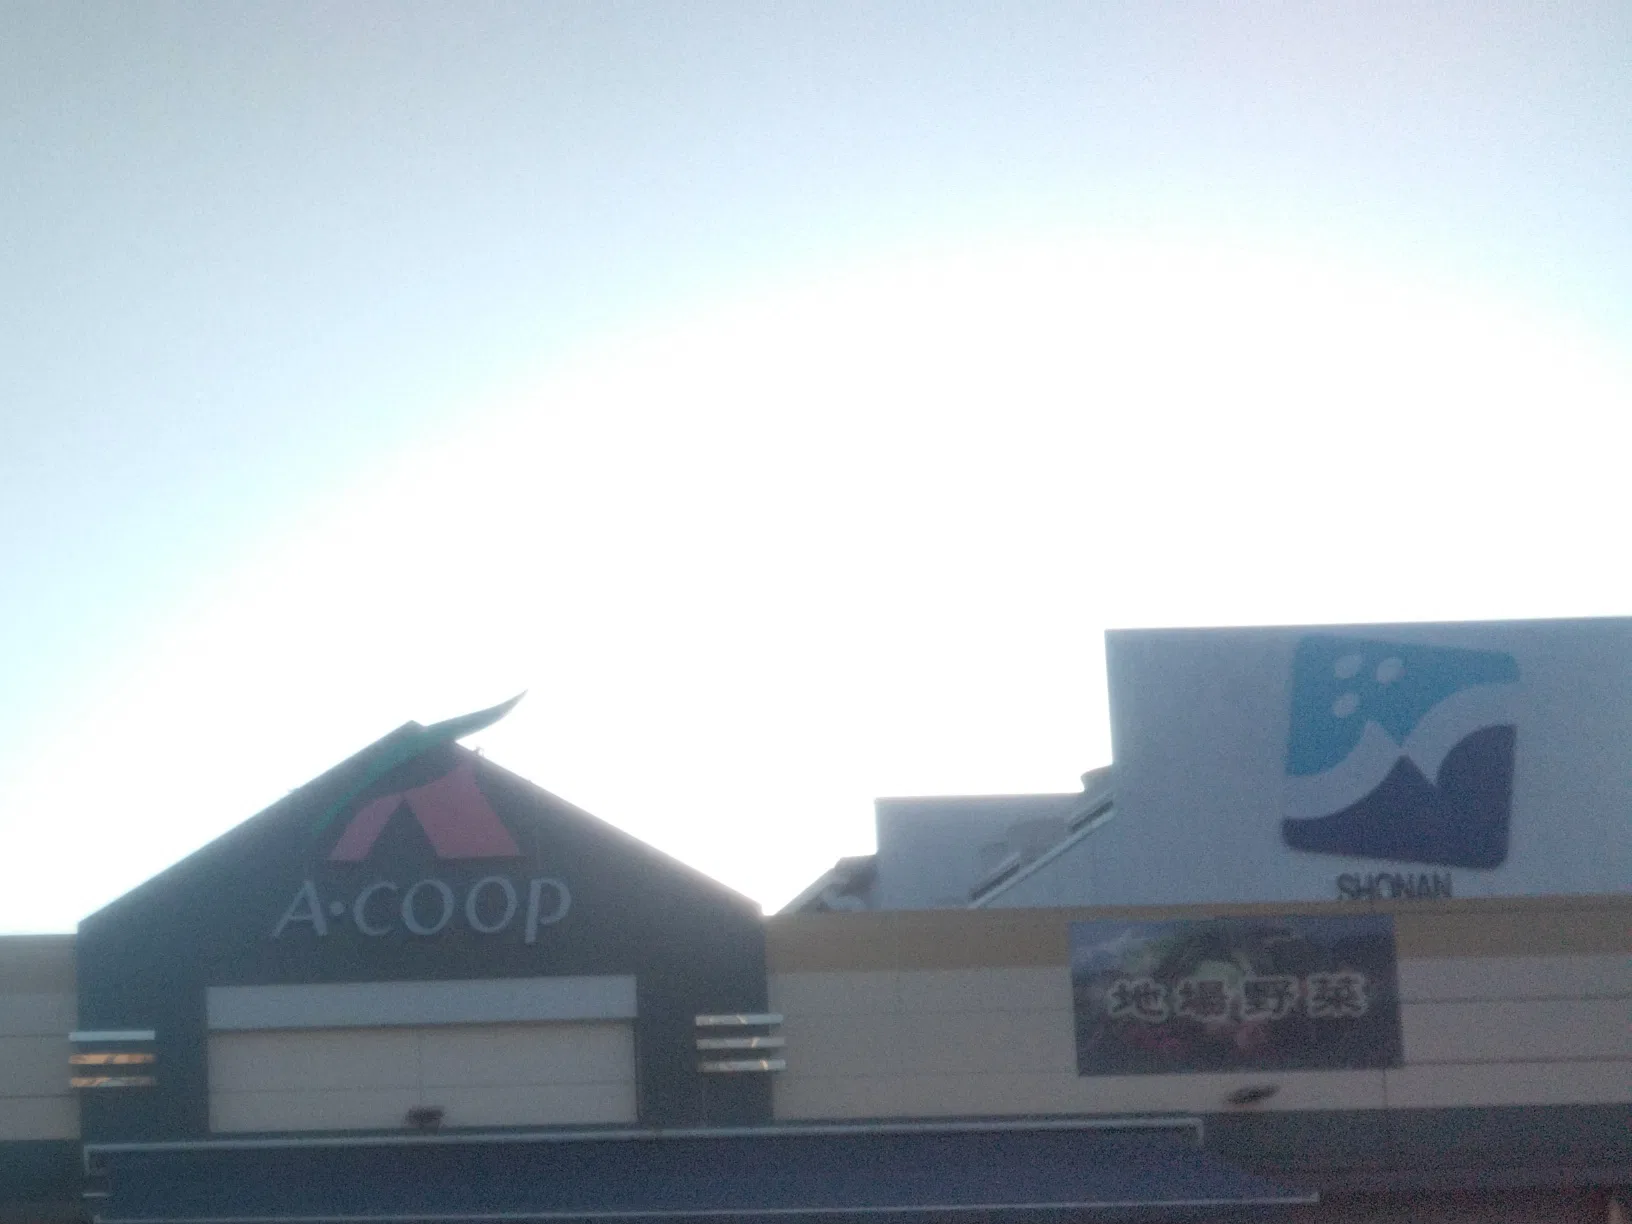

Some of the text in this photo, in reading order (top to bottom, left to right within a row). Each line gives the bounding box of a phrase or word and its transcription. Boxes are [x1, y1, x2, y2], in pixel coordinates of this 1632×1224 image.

[1335, 870, 1453, 901] SHONAN
[1107, 971, 1369, 1022] 地場野菜
